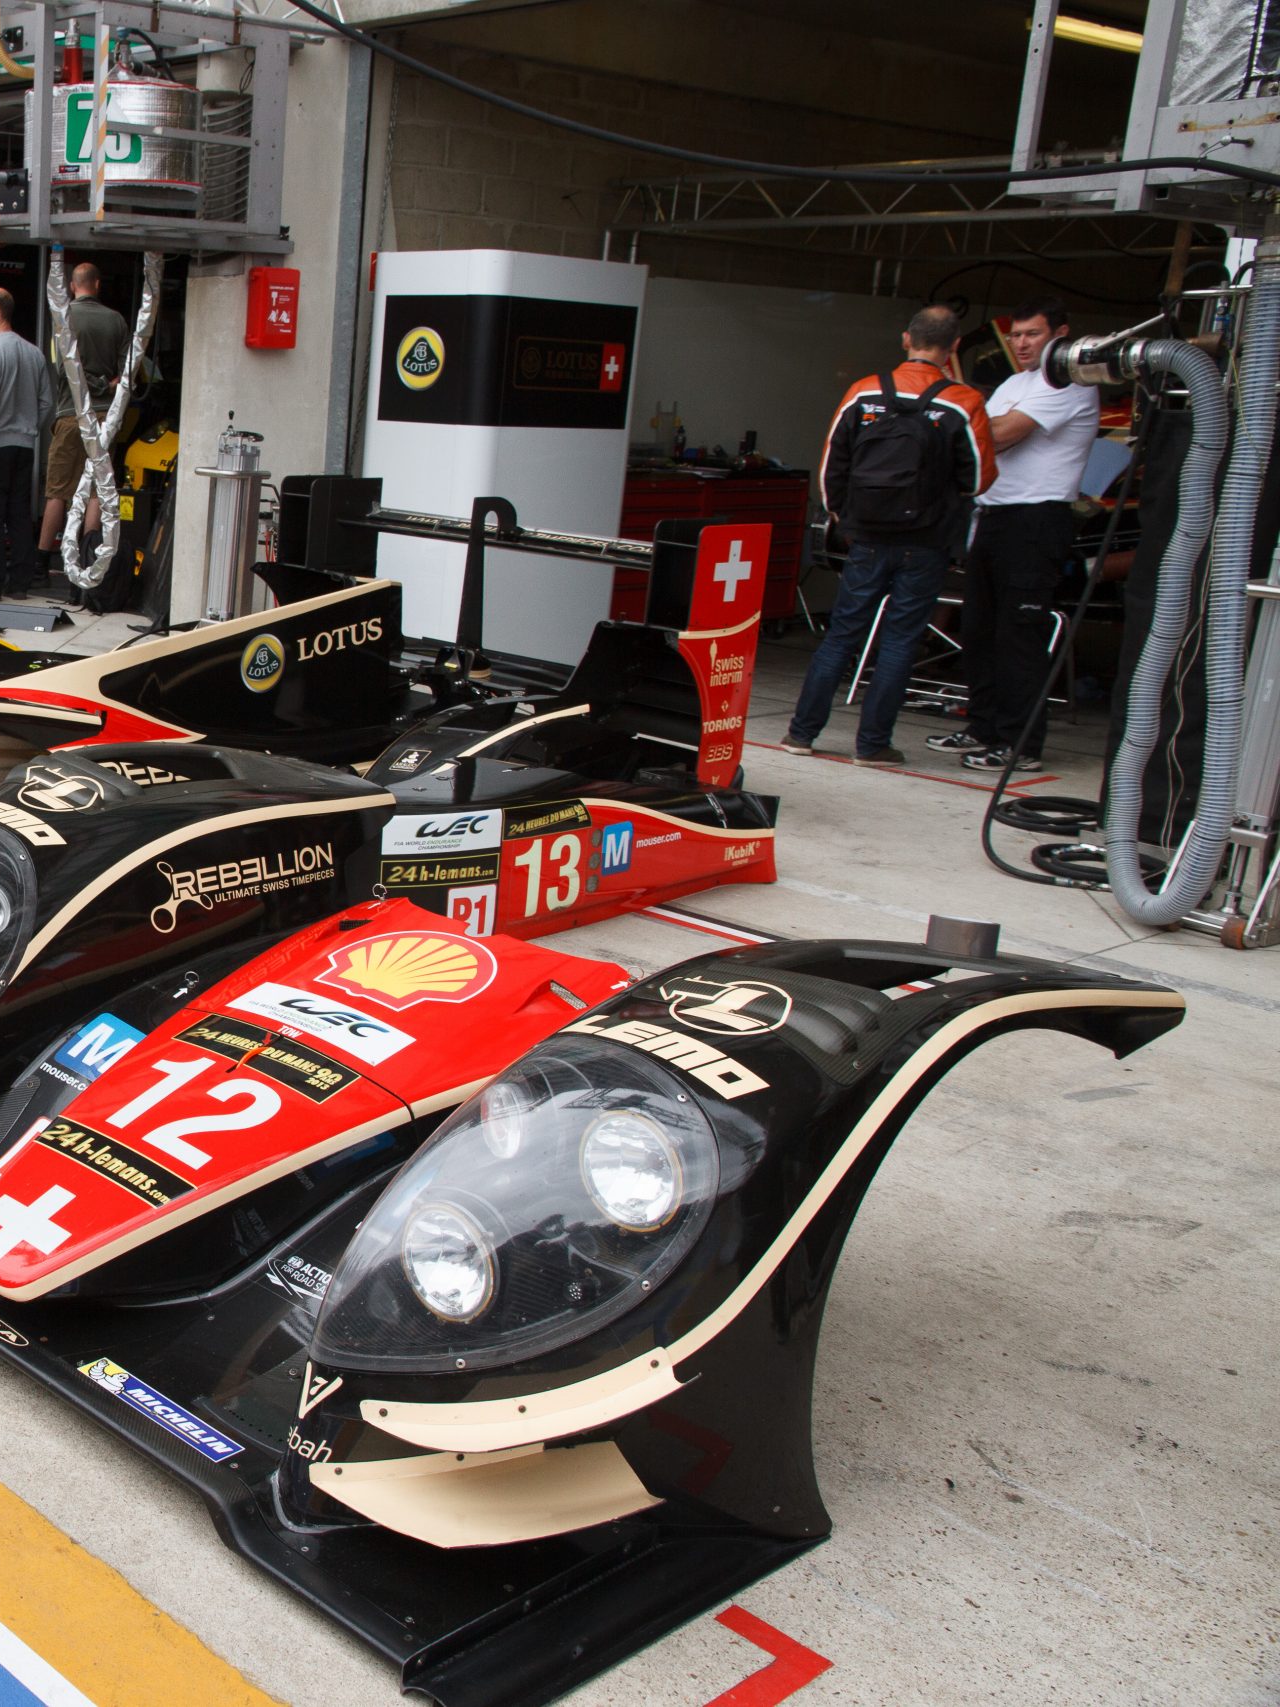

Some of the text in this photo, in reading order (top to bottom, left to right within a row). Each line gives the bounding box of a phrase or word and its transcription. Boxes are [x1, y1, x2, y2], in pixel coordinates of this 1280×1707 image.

[404, 358, 438, 373] LOTUS
[297, 617, 382, 661] LOTUS
[248, 660, 279, 678] LOTUS
[715, 653, 744, 672] swiss
[710, 669, 743, 687] interim
[703, 715, 743, 734] TORNOS
[705, 743, 733, 763] BBS
[416, 815, 490, 837] WEC
[508, 822, 525, 836] 24
[525, 815, 550, 830] HEURES
[604, 830, 630, 868] M
[636, 831, 682, 849] mouser.com
[172, 842, 334, 899] REBELLION
[515, 834, 581, 918] 13
[215, 868, 335, 903] ULTIMATE SWISS TIMEPIECES
[452, 895, 488, 935] P1
[279, 998, 391, 1038] WEC
[276, 1025, 303, 1039] TOW
[67, 1022, 139, 1074] M
[185, 1027, 218, 1041] 24
[218, 1032, 264, 1050] HEURES
[262, 1046, 282, 1060] DU
[281, 1050, 319, 1073] MANS
[558, 1014, 771, 1100] LEMO
[304, 1077, 331, 1091] 2013
[105, 1057, 282, 1171] 12
[281, 1264, 294, 1274] FOR
[291, 1270, 315, 1288] ROAD
[299, 1263, 332, 1285] ACTIO
[126, 1388, 234, 1455] MICHELIN
